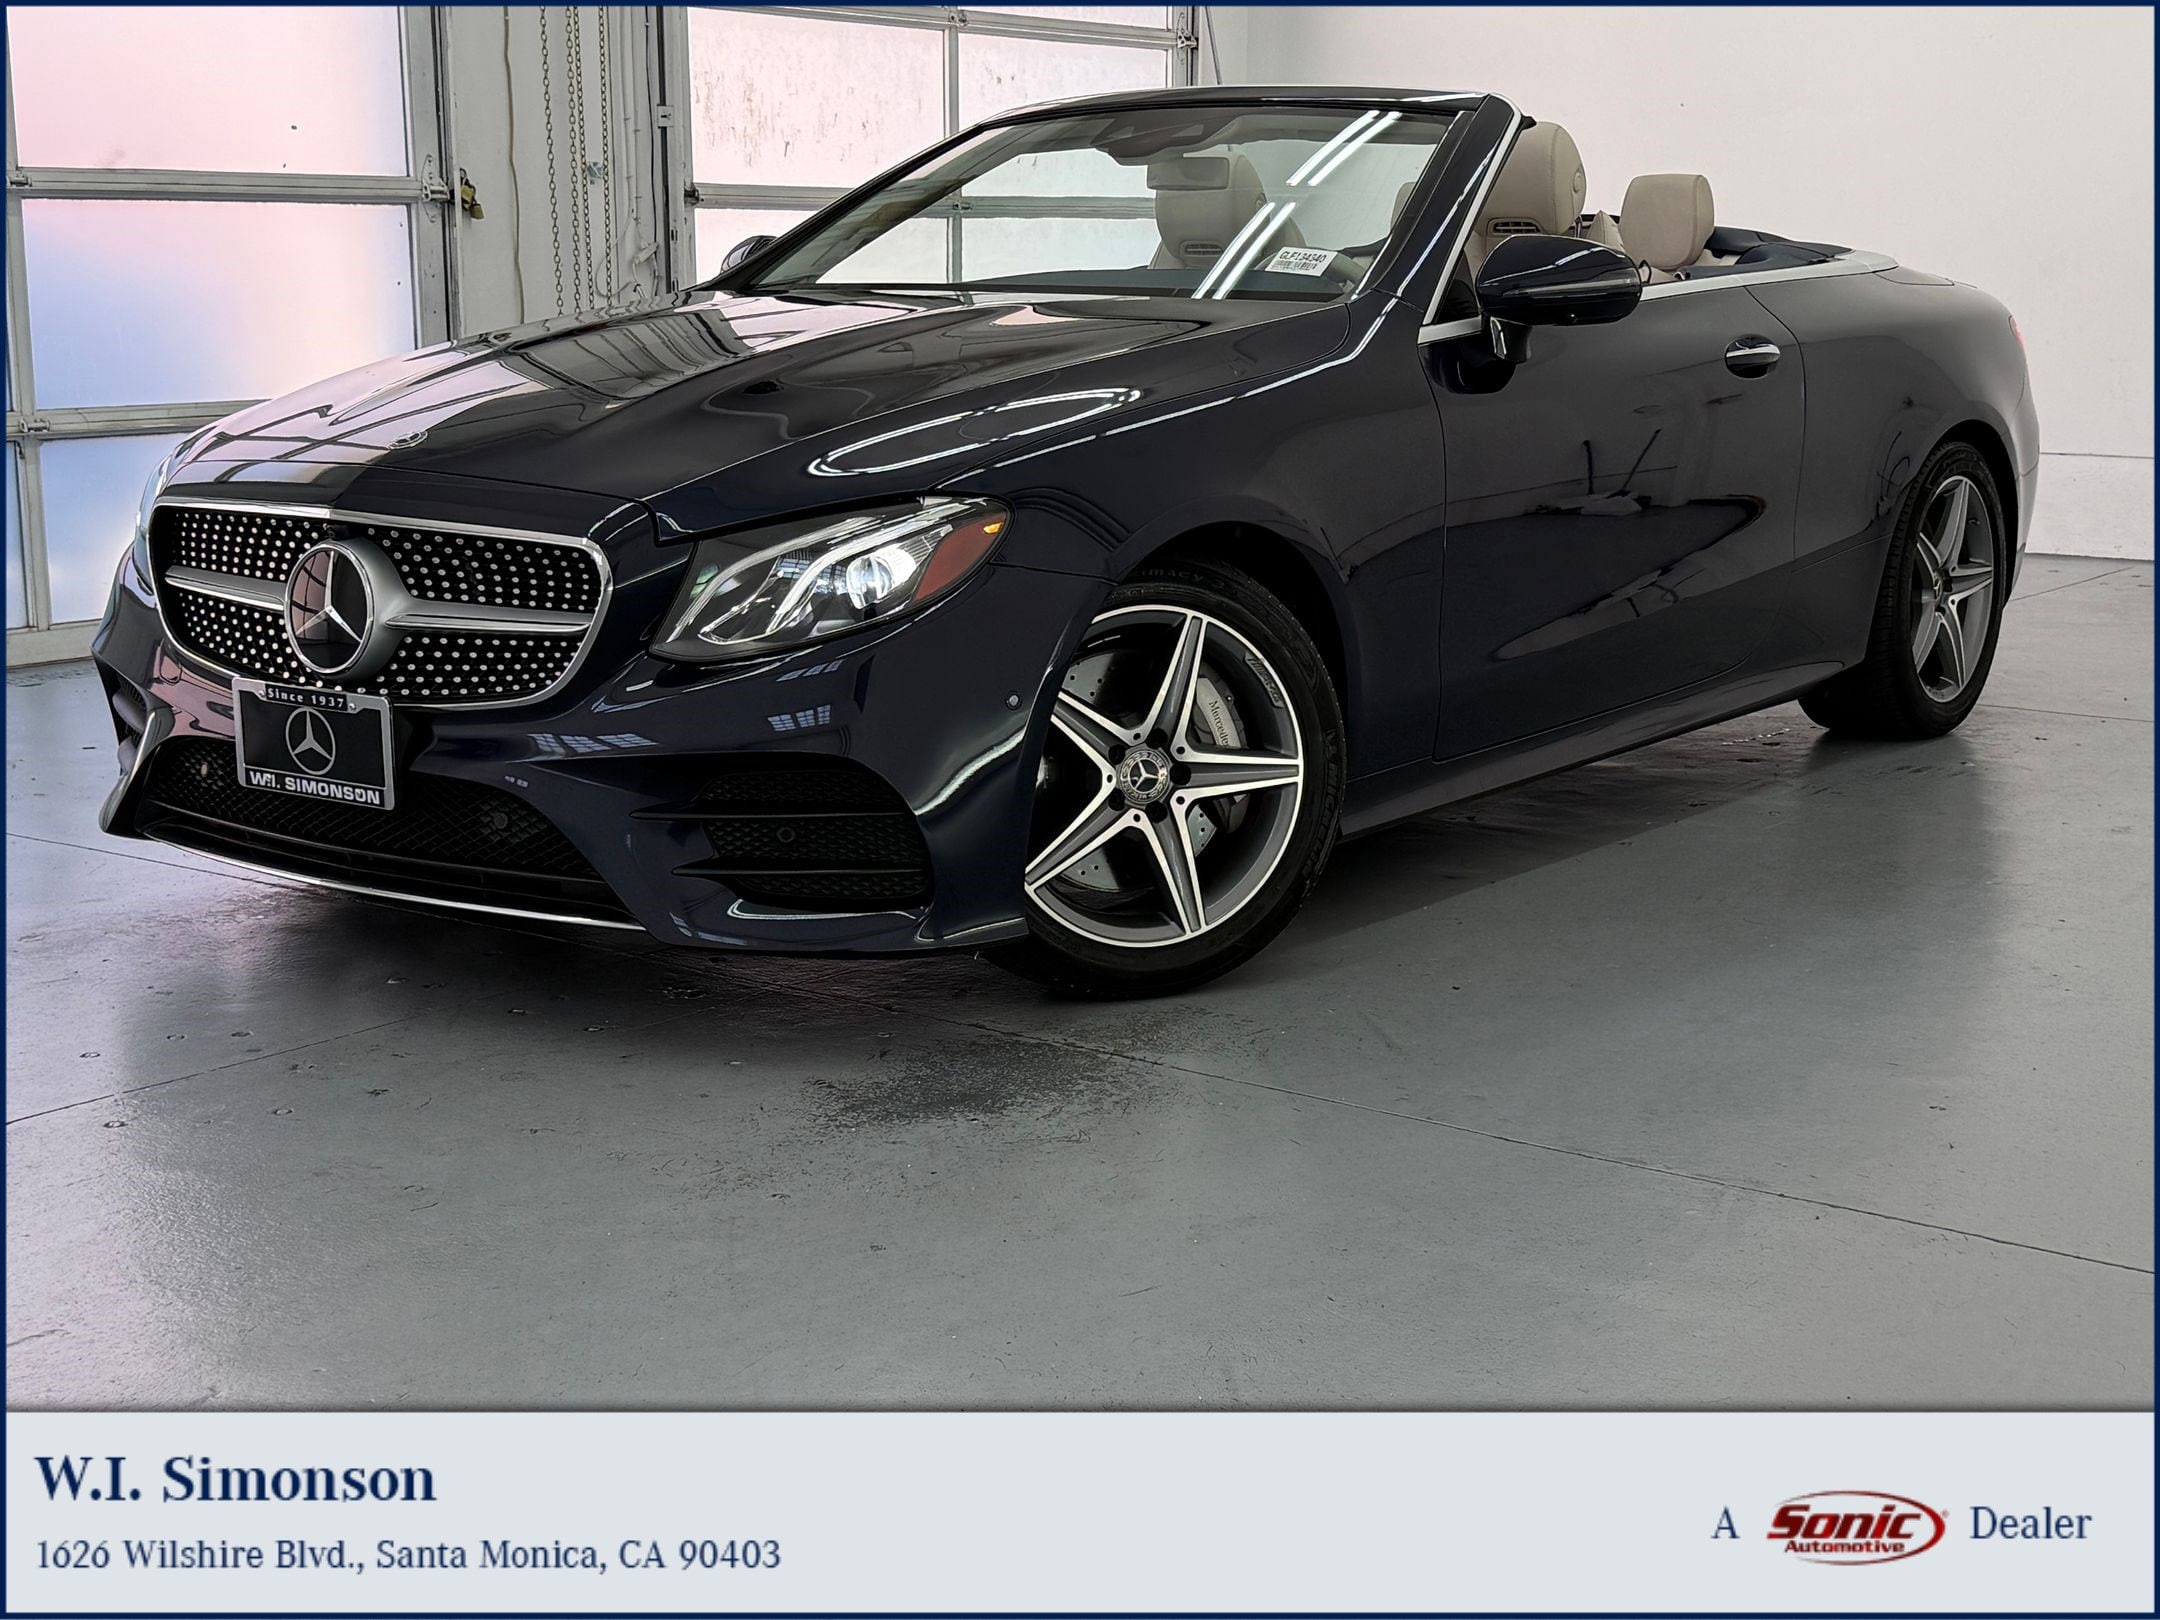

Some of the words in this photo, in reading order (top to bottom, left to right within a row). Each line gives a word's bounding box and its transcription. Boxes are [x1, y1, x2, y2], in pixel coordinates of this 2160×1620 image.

[267, 688, 304, 703] Since
[310, 694, 345, 709] 1937
[1208, 700, 1231, 748] Mercede
[284, 777, 381, 804] SIMONSON
